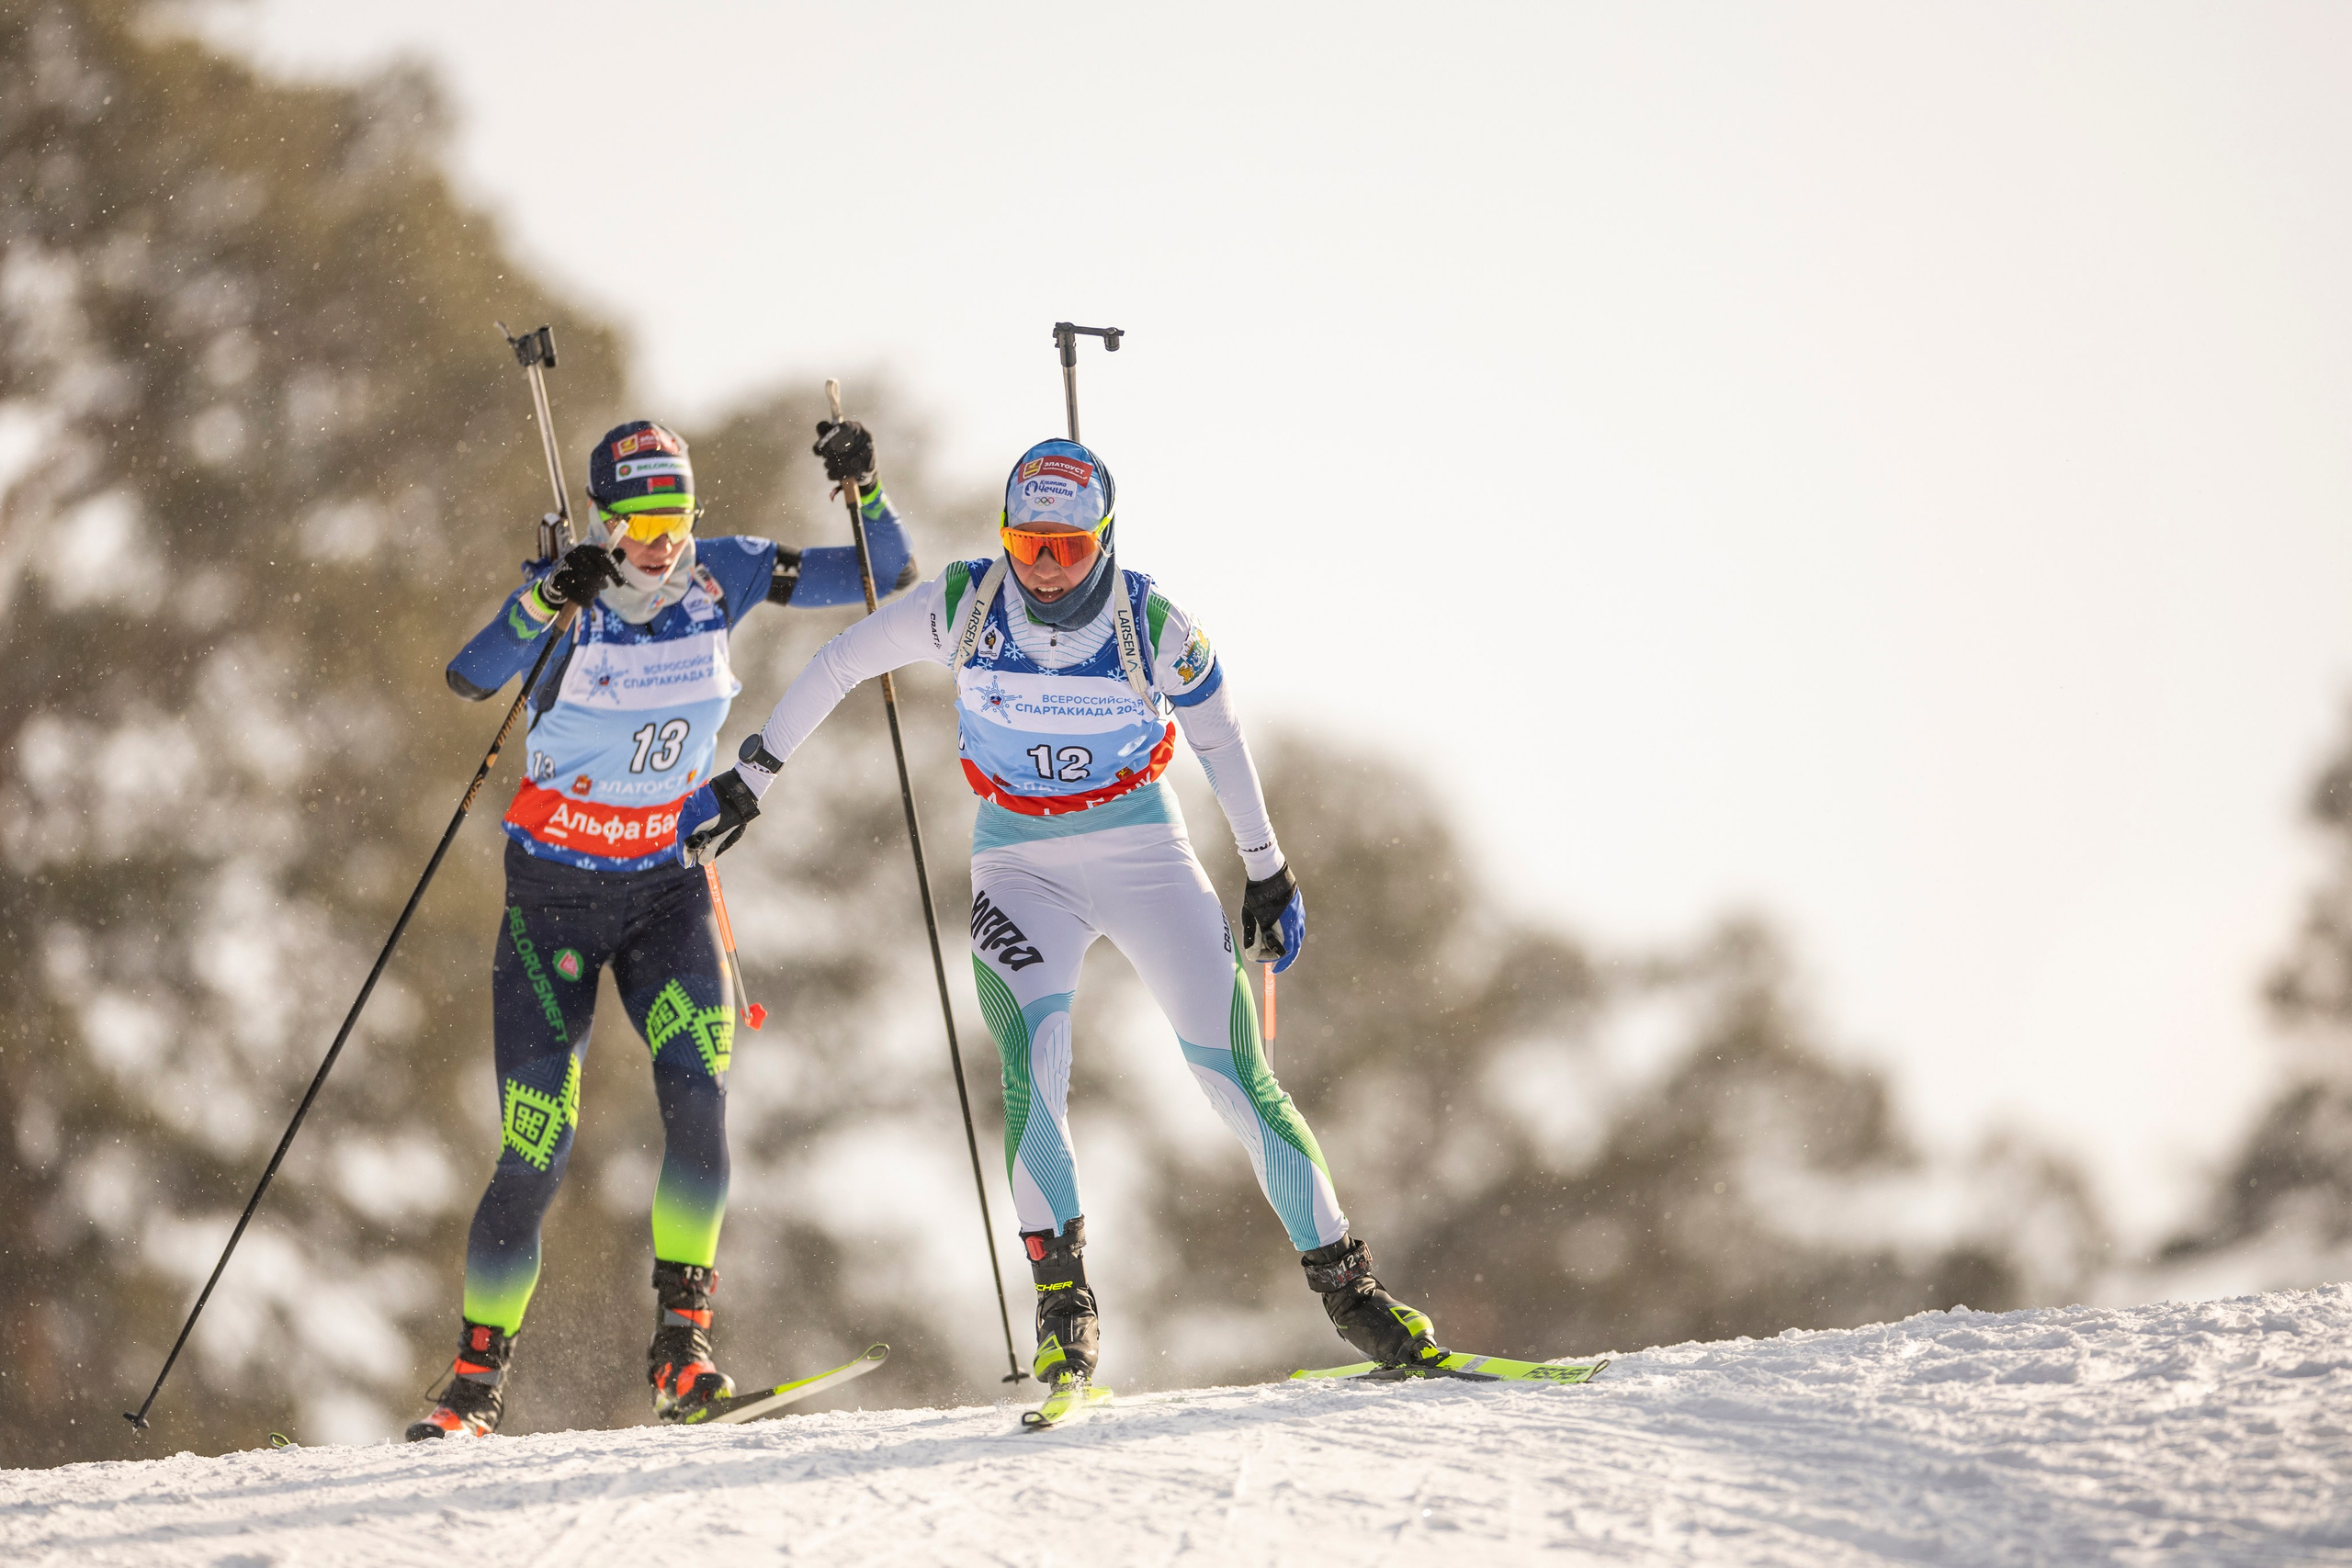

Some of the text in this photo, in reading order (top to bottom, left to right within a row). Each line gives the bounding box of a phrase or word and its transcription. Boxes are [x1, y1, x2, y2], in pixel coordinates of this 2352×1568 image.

[1045, 462, 1085, 474] ЗЛАТОУСТ
[930, 613, 941, 643] CRAFT
[963, 599, 986, 647] LARSEN
[1117, 610, 1136, 657] LARSEN
[623, 670, 705, 689] СПАРТАКИАДА
[1015, 703, 1114, 717] СПАРТАКИАДА
[629, 717, 690, 773] 13
[532, 750, 557, 780] 13
[1026, 744, 1092, 782] 12
[548, 803, 640, 845] Альфа
[509, 905, 569, 1043] BELORUSNEFT
[684, 1266, 705, 1281] 13
[1339, 1254, 1357, 1272] 12
